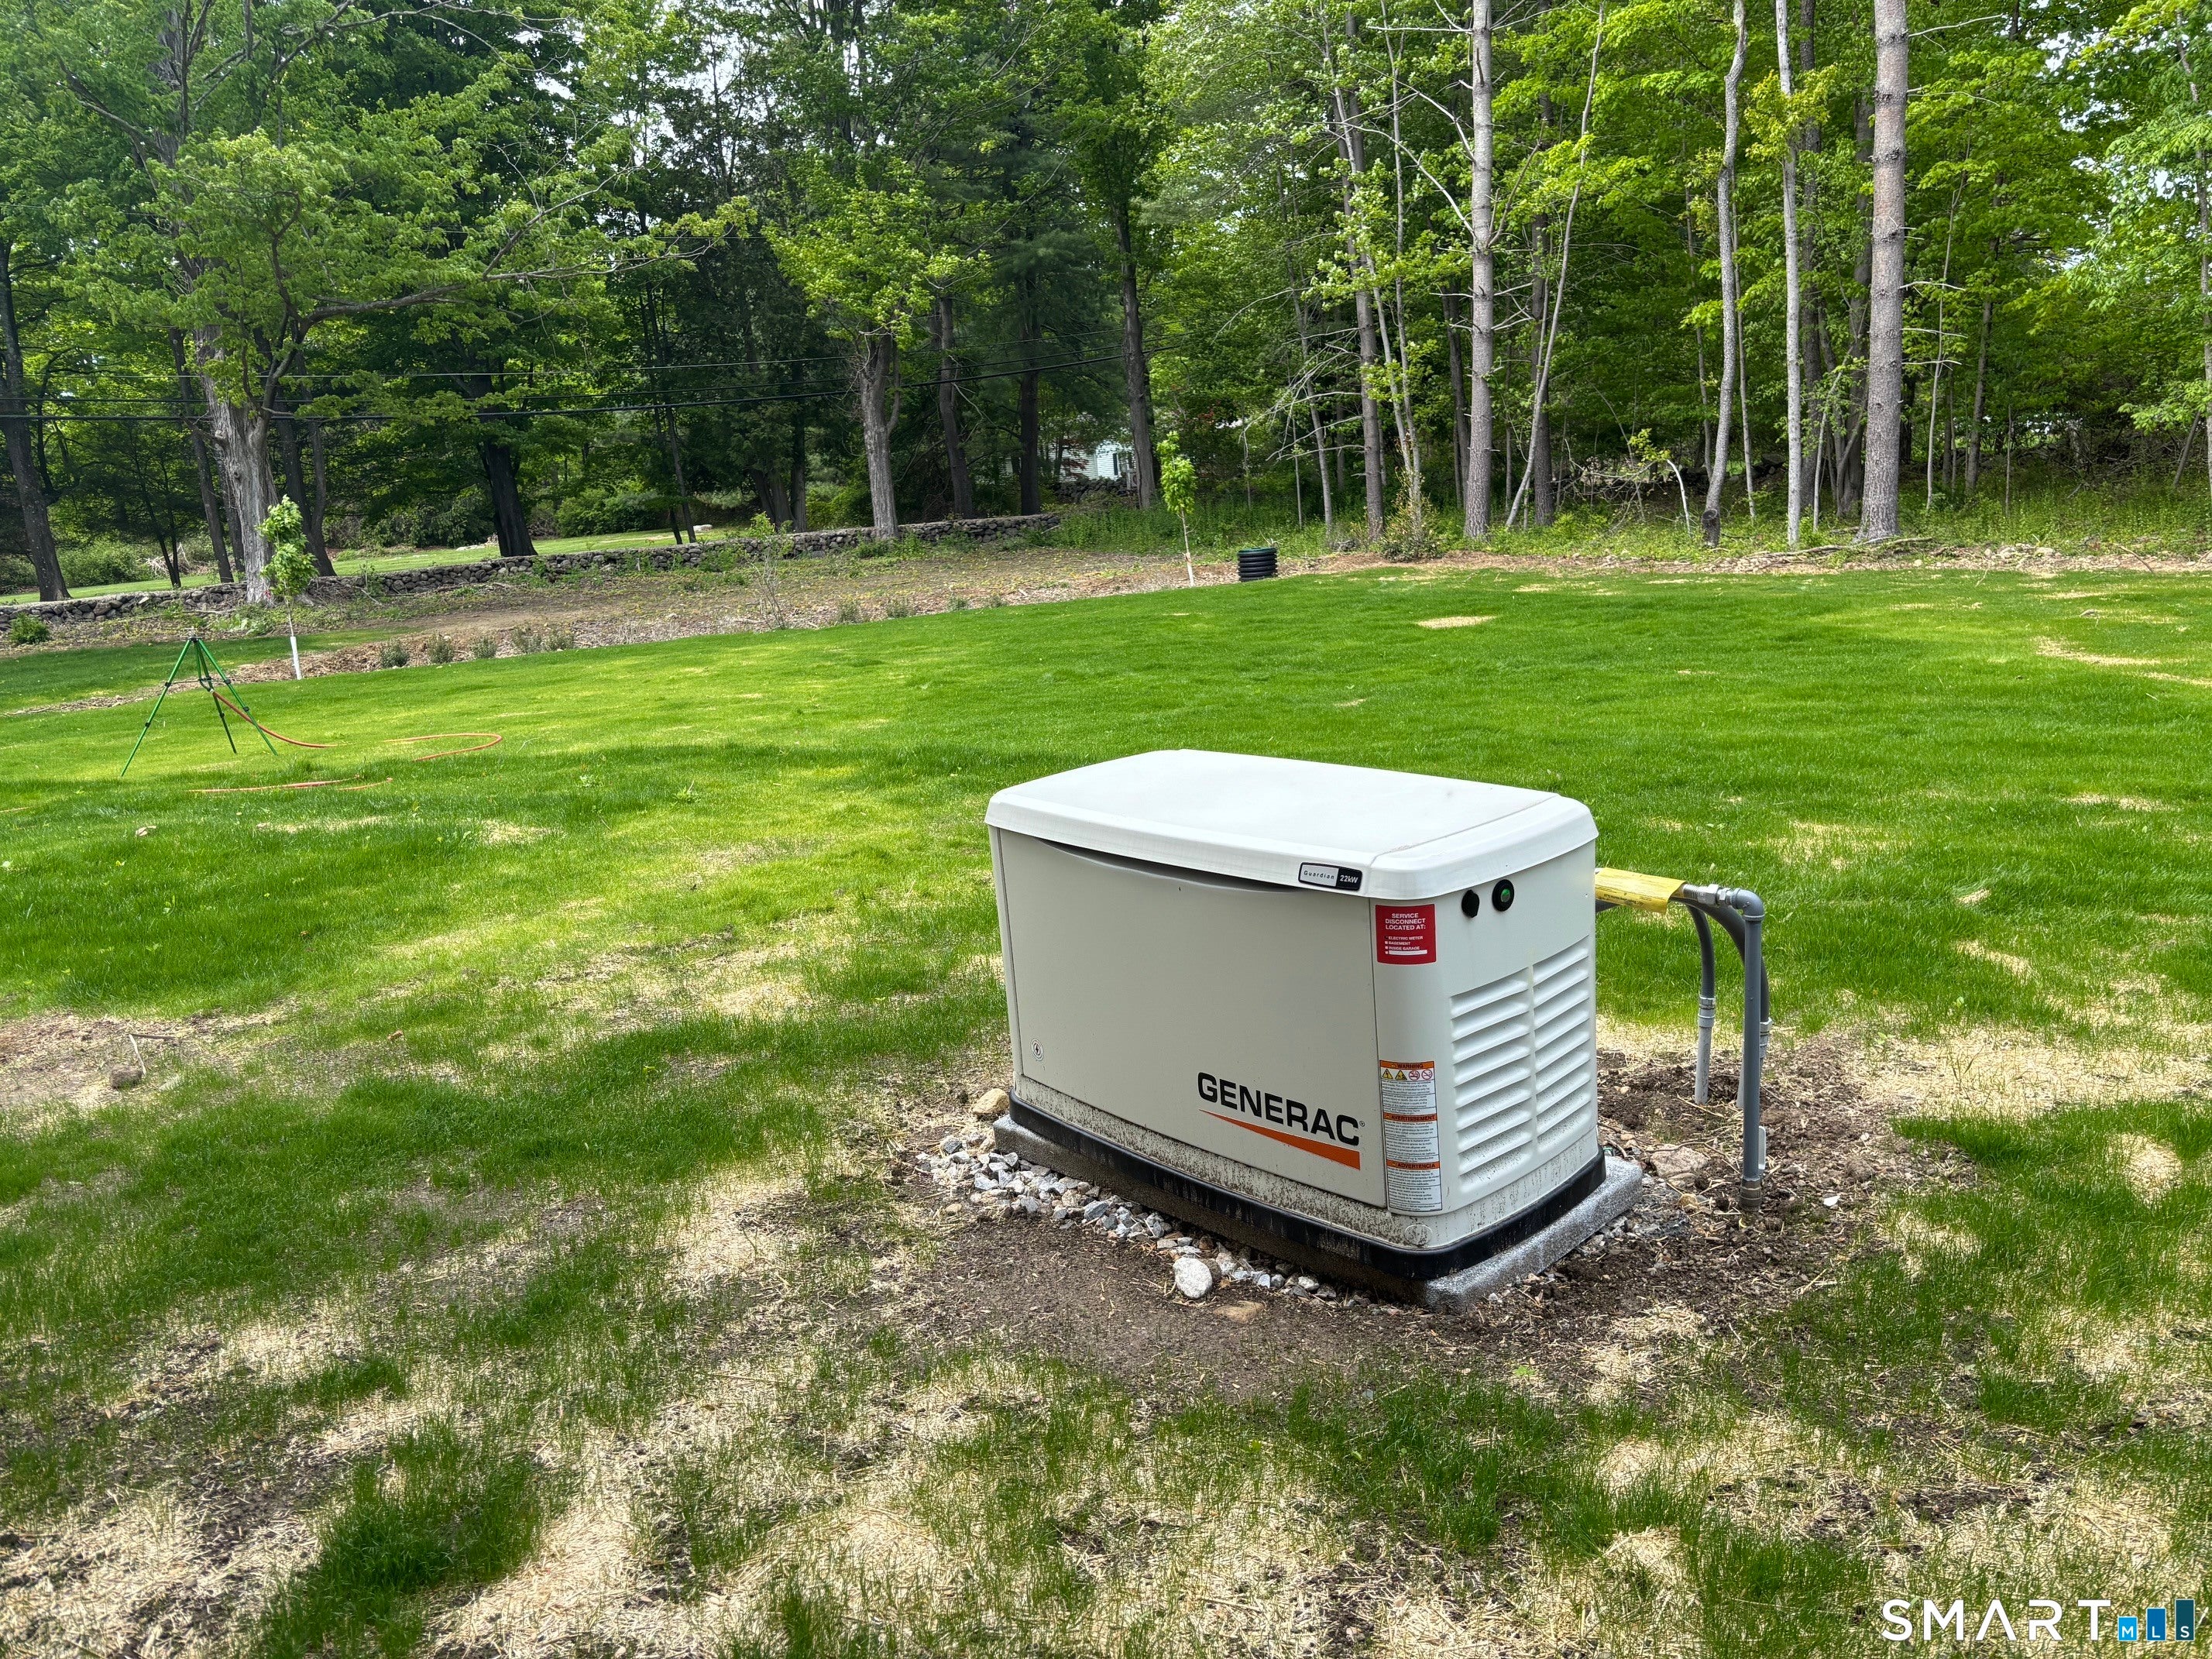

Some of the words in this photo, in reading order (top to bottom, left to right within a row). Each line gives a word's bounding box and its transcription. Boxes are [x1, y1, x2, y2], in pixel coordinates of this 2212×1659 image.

[1304, 870, 1334, 880] Guardian
[1339, 874, 1358, 884] 22kW
[1197, 1072, 1359, 1146] GENERAC
